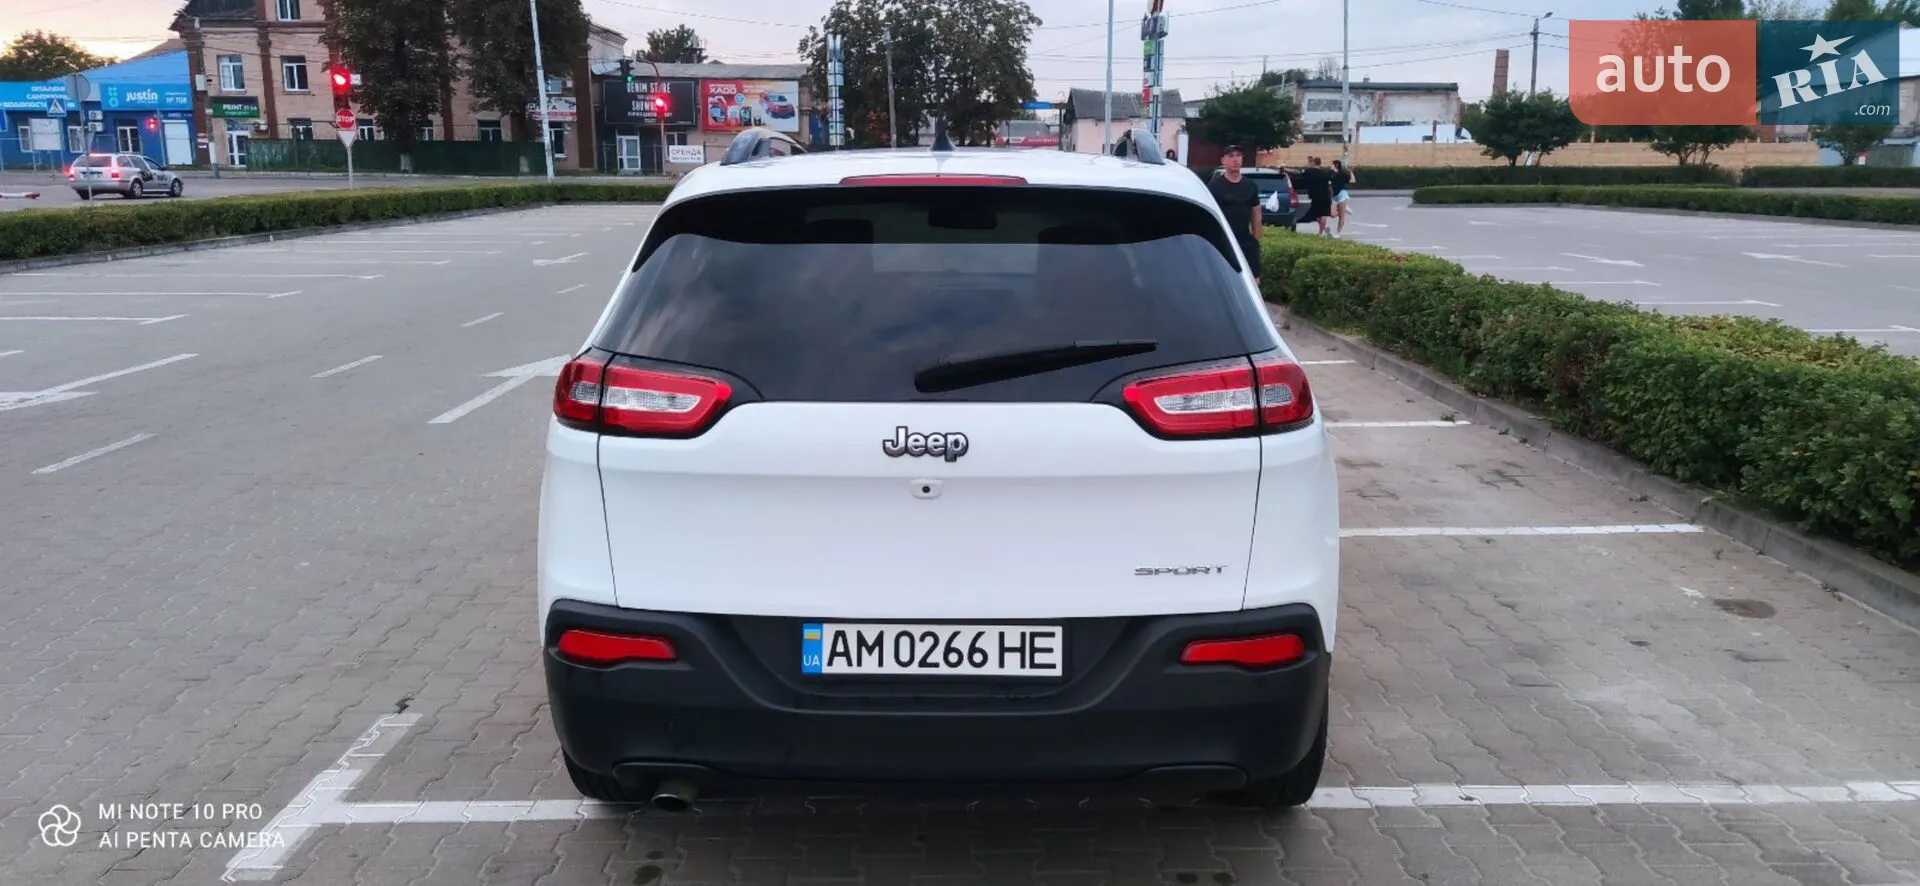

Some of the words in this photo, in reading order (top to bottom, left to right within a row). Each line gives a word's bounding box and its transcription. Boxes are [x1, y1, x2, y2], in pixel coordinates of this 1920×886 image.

[126, 88, 158, 102] justin
[336, 115, 355, 123] STOP
[882, 425, 969, 463] Jeep
[1134, 564, 1228, 576] SPORT
[826, 629, 885, 668] AM
[893, 630, 989, 669] 0266
[998, 631, 1057, 670] HE
[803, 655, 820, 666] UA
